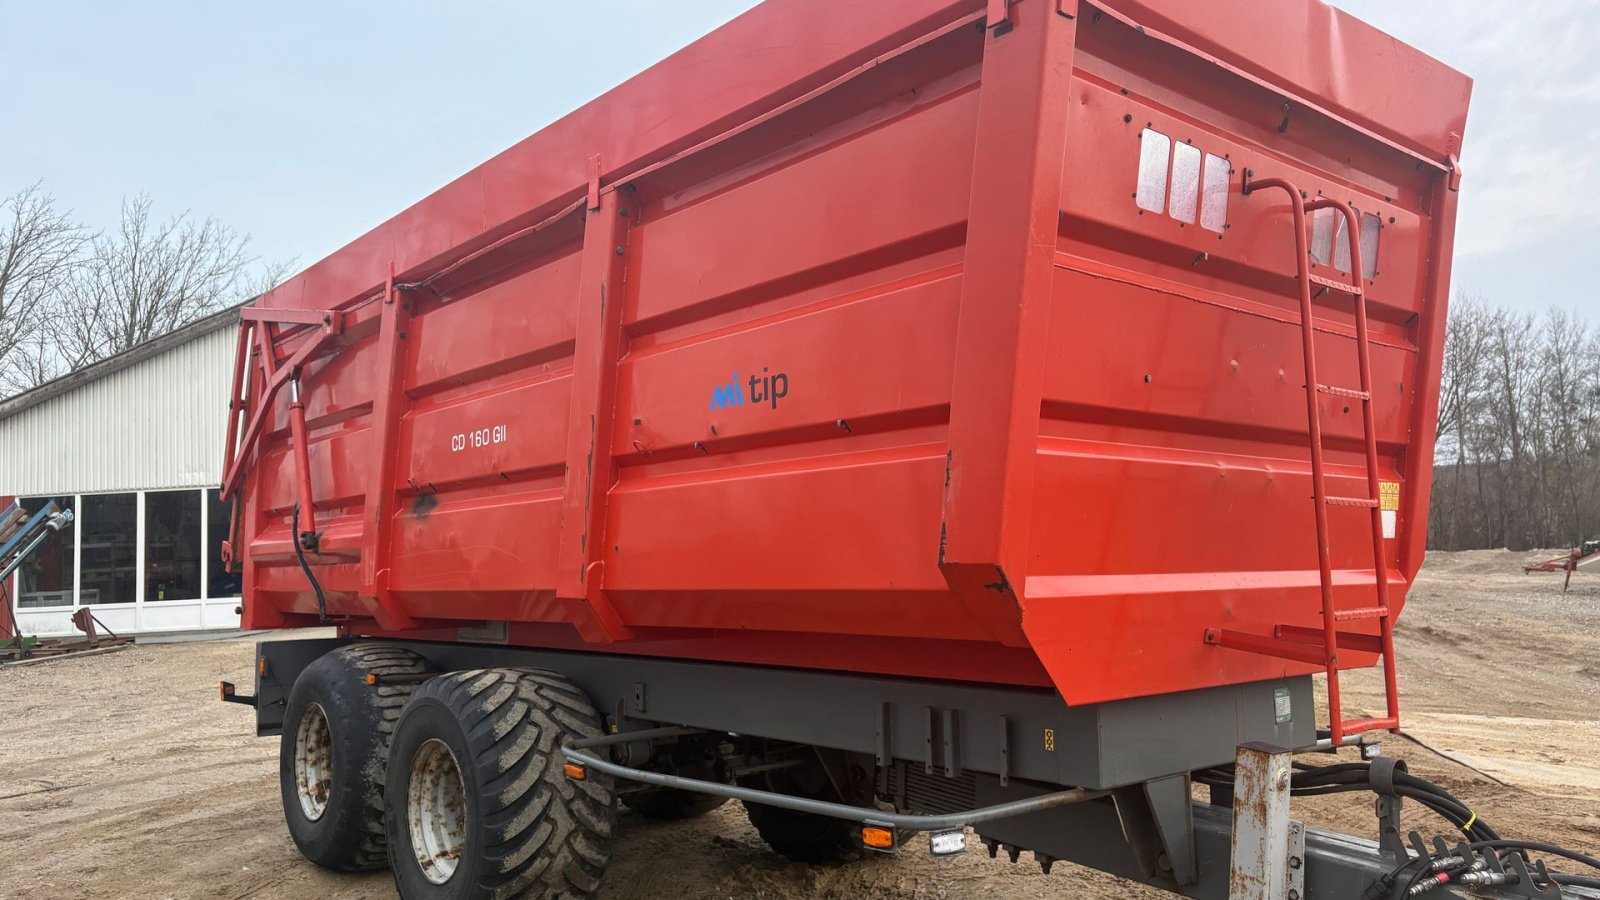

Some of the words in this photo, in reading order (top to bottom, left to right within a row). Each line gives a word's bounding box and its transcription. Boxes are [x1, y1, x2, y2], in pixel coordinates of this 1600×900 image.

[749, 367, 788, 410] tip
[451, 433, 465, 452] CD
[469, 428, 490, 448] 160
[493, 424, 506, 443] GII
